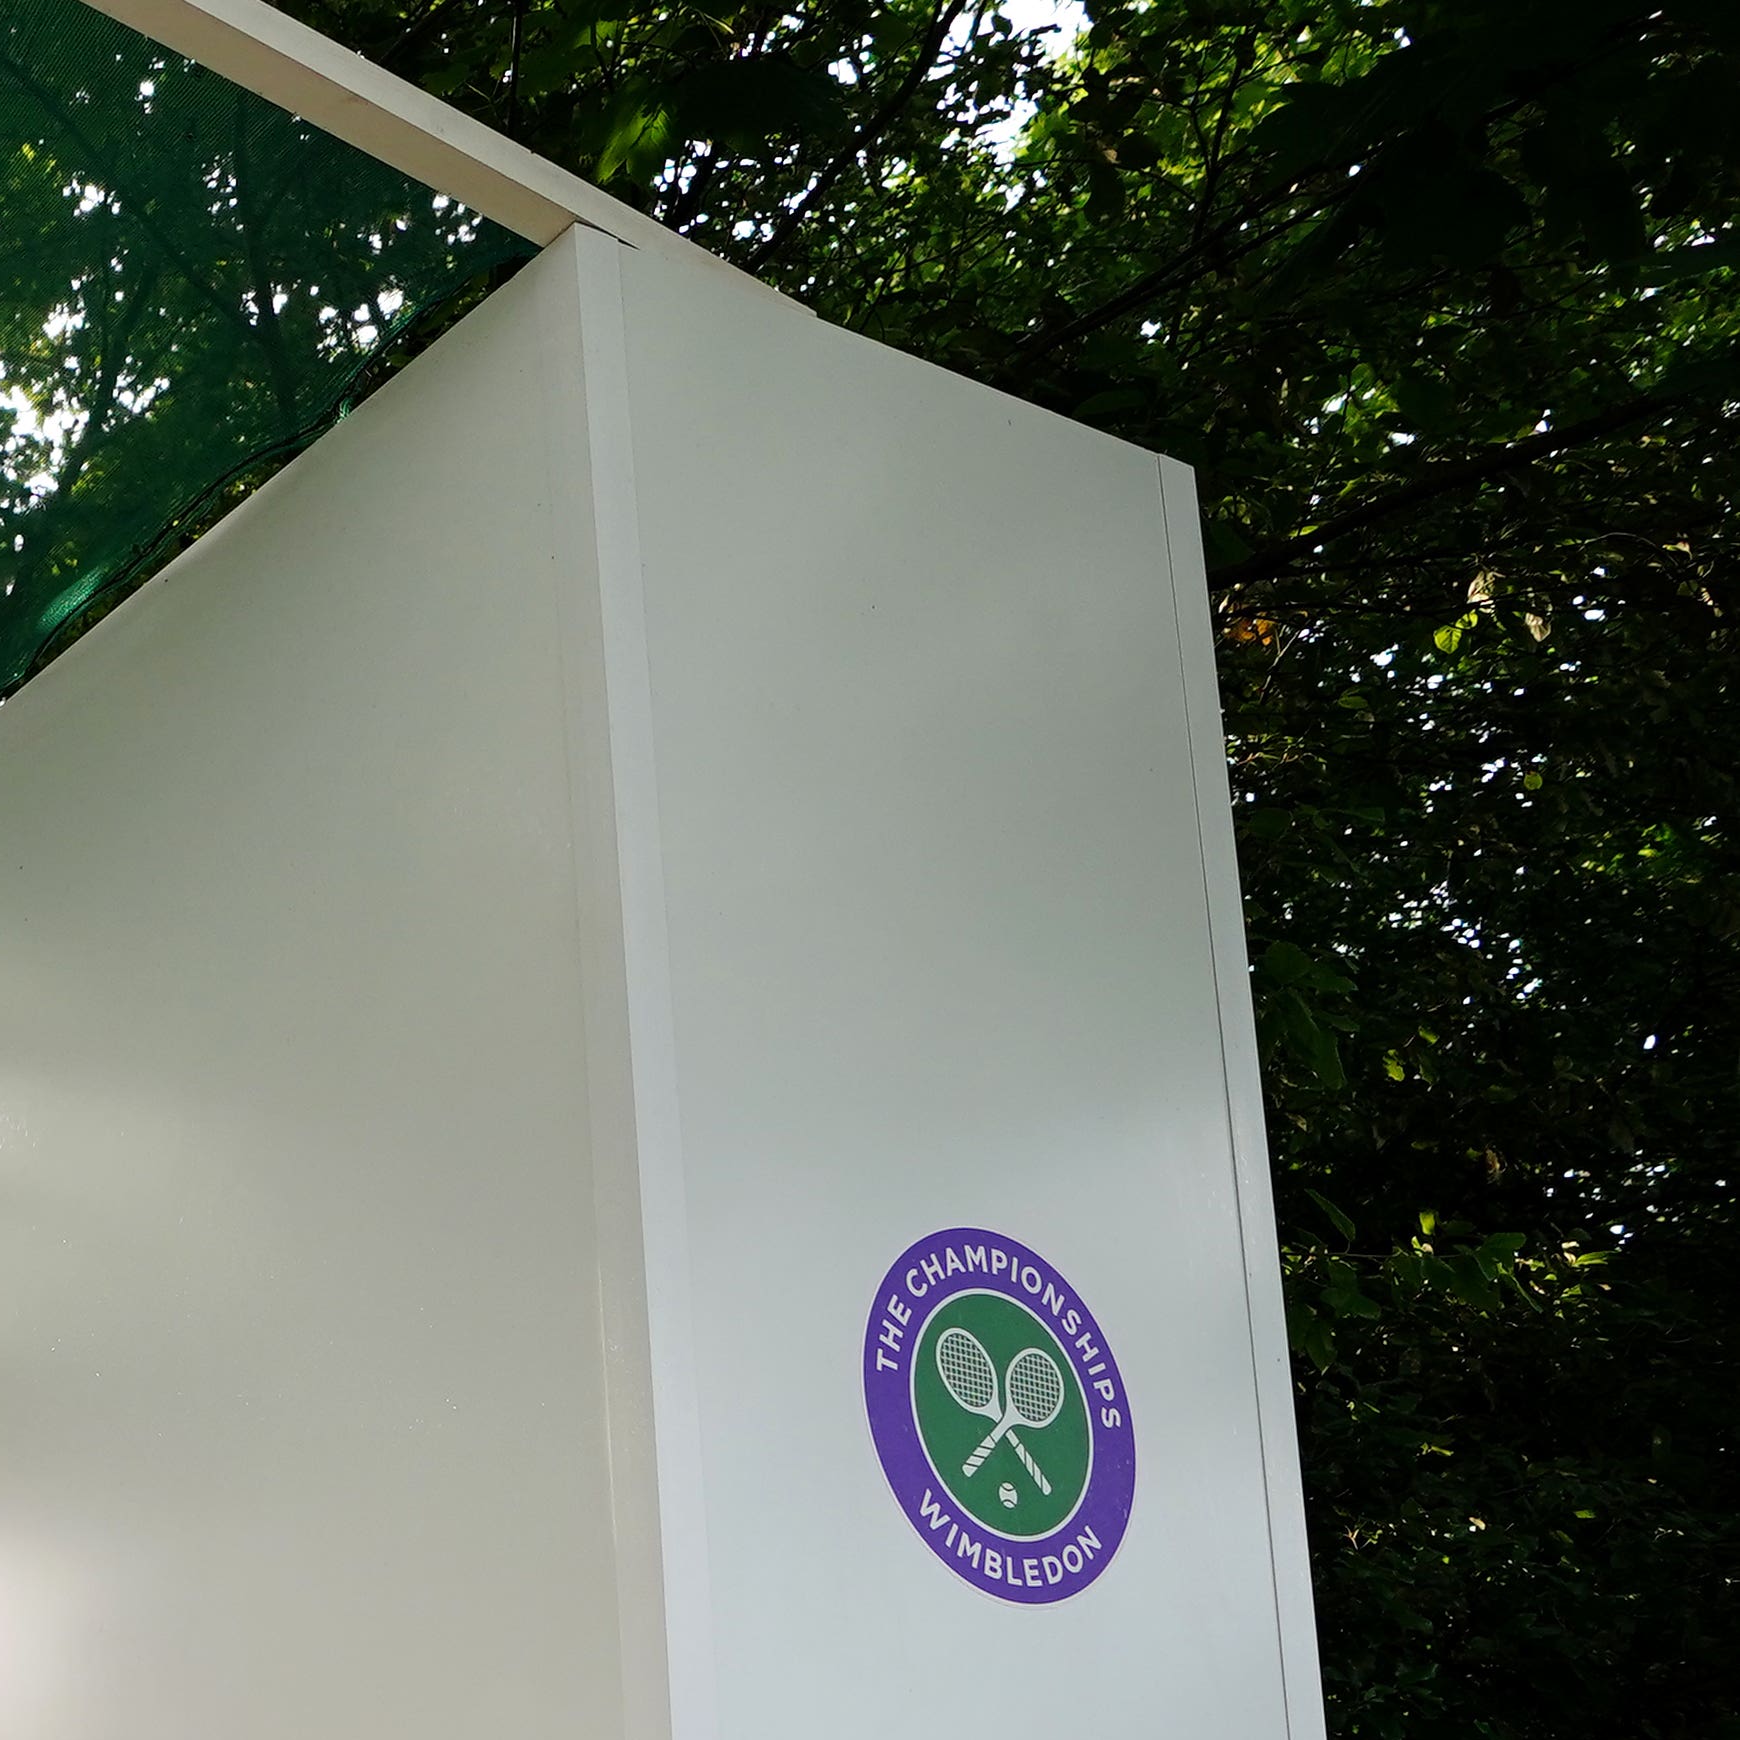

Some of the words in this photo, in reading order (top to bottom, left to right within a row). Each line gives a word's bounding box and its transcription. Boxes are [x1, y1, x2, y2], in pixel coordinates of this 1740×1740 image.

[876, 1295, 913, 1374] THE
[905, 1244, 1121, 1430] CHAMPIONSHIPS
[920, 1488, 1103, 1587] WIMBLEDON
